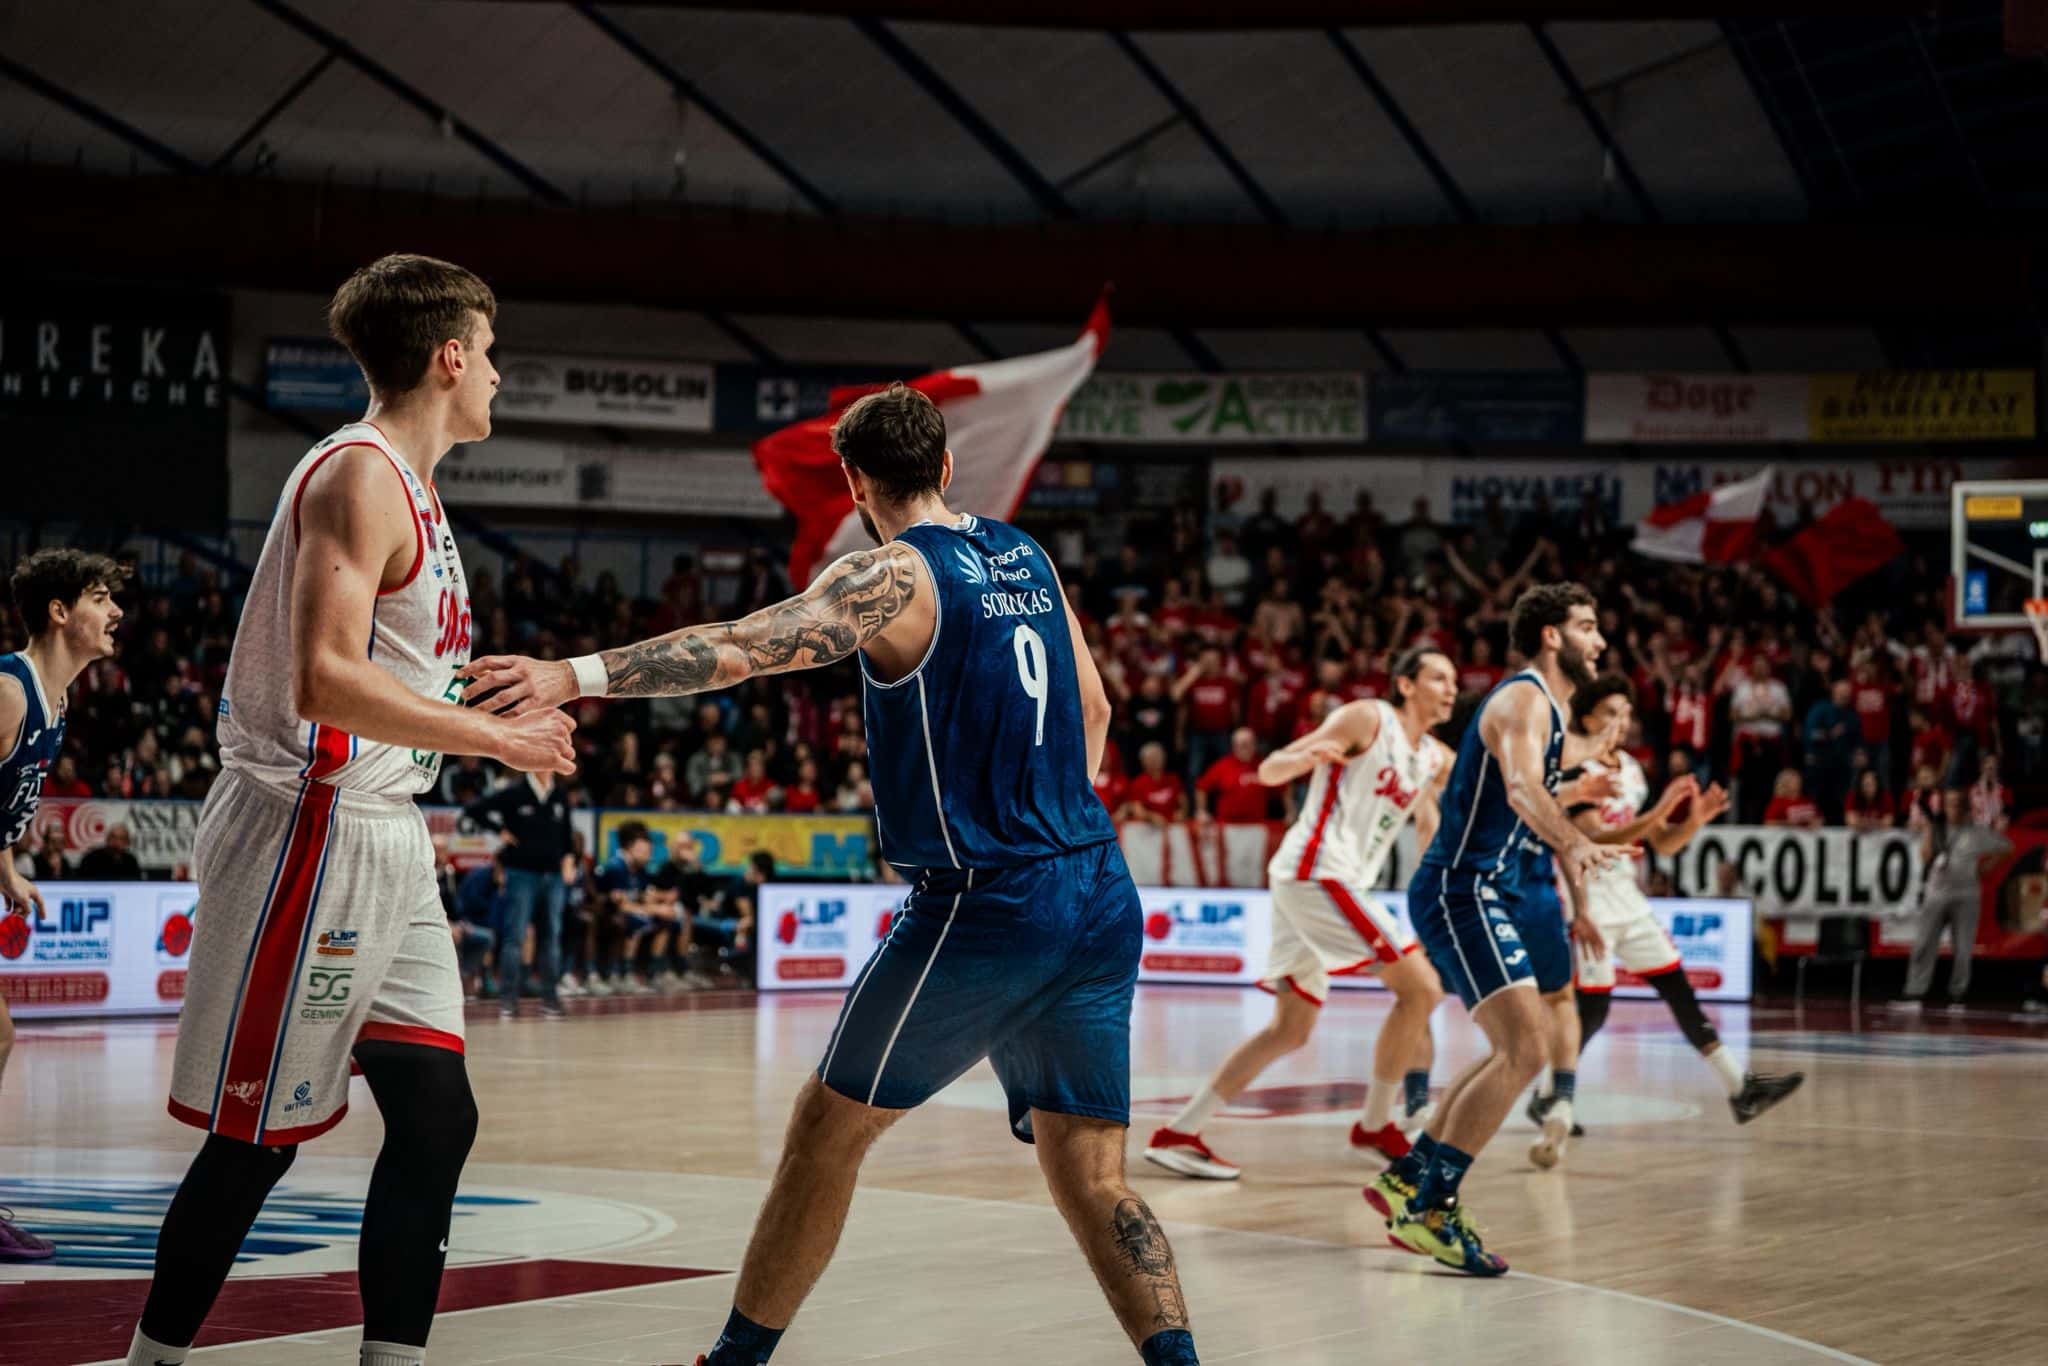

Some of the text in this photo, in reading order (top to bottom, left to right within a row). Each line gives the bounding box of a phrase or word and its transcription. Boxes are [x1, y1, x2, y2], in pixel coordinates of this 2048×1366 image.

[0, 319, 221, 382] REKA
[564, 368, 706, 399] BUSOLIN
[1013, 624, 1048, 747] 9
[33, 900, 110, 934] LNP
